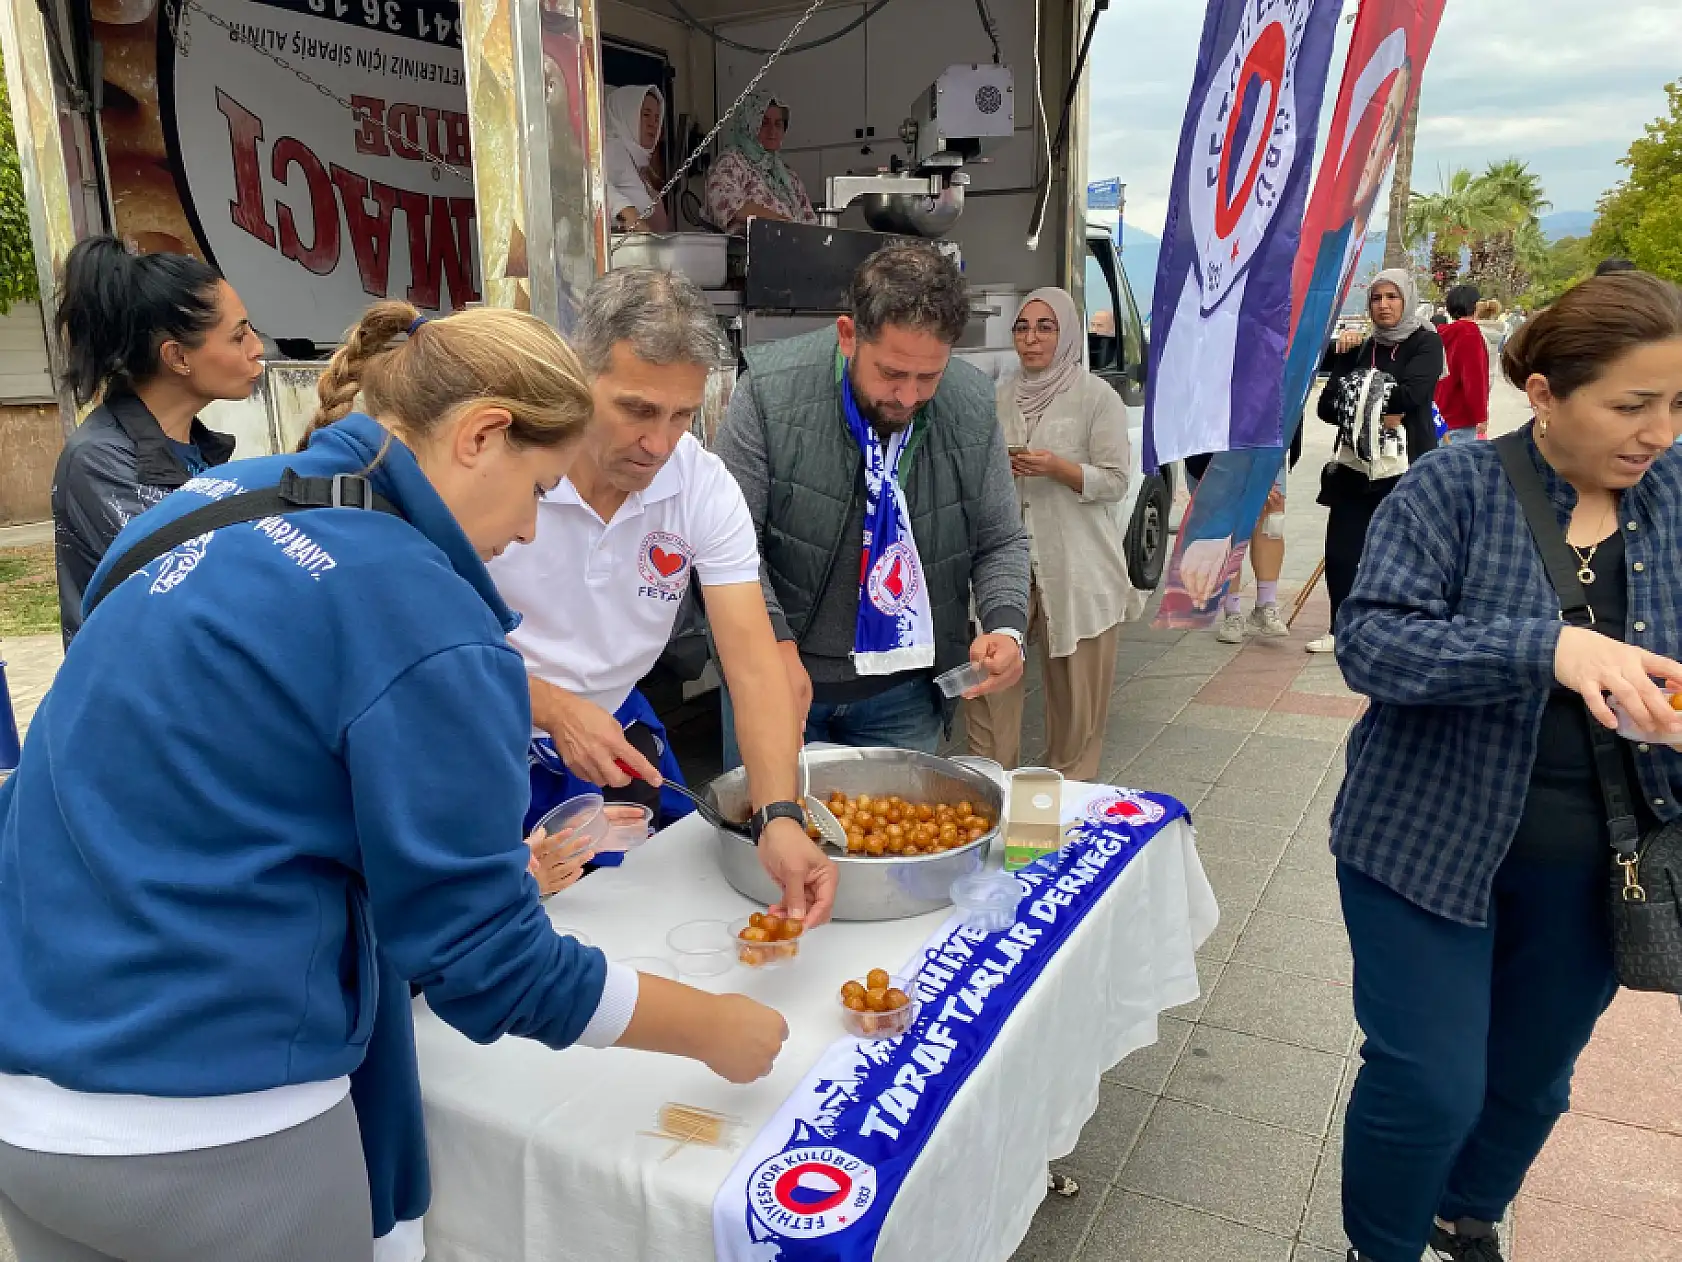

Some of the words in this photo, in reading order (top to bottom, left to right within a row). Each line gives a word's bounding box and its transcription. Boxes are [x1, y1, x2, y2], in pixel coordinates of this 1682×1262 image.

[363, 0, 401, 30] 36
[292, 29, 352, 68] SİPARİŞ
[356, 47, 387, 76] İÇİN
[859, 921, 1042, 1141] TARAFTARLAR
[757, 1163, 826, 1230] FETHİYESPOR
